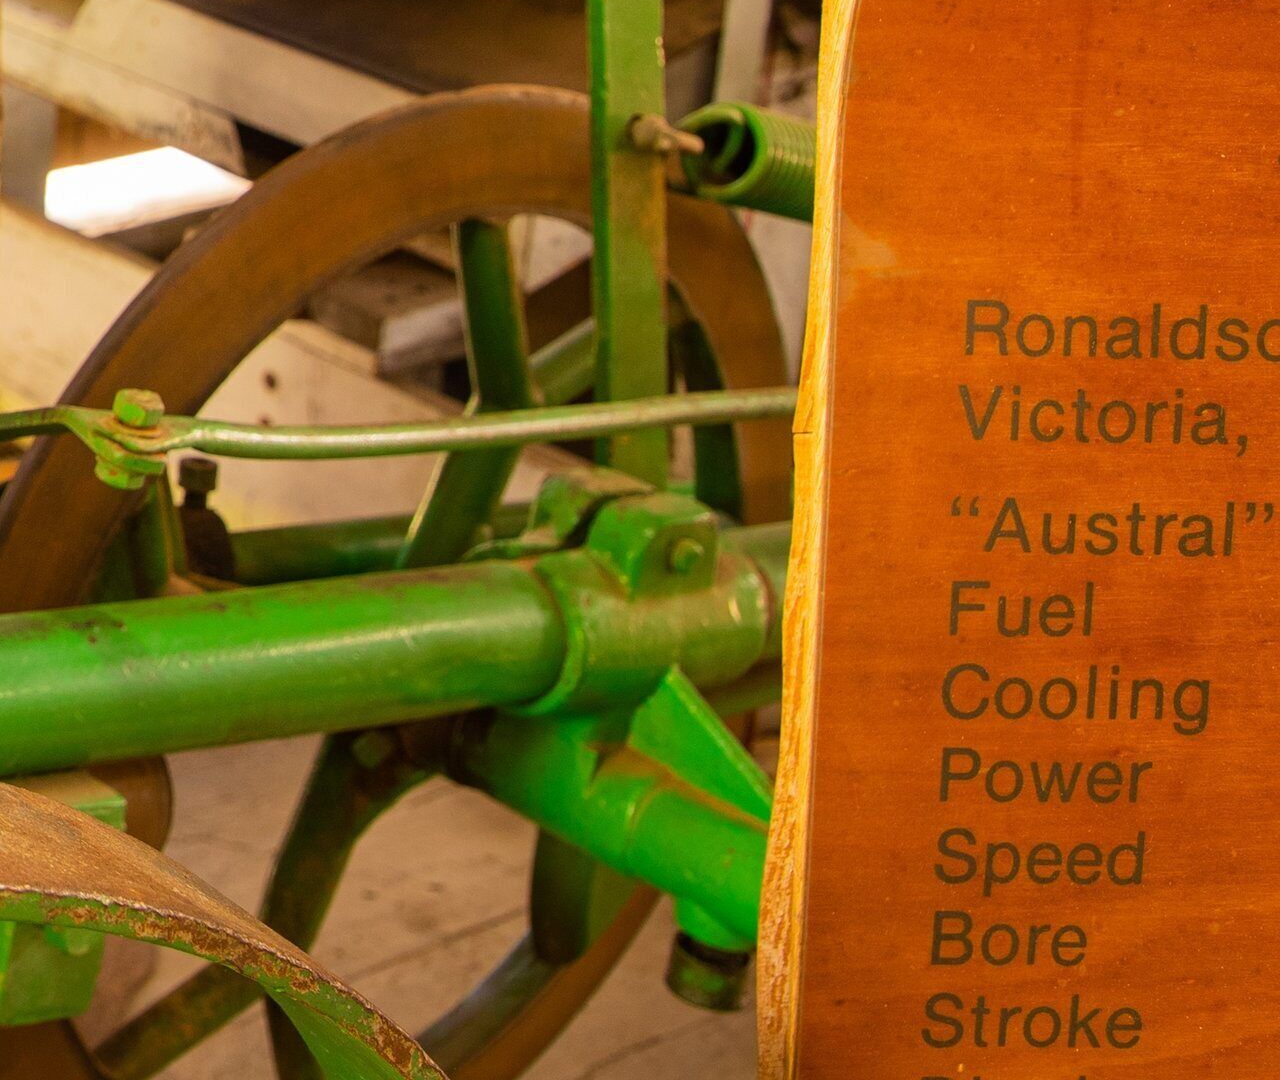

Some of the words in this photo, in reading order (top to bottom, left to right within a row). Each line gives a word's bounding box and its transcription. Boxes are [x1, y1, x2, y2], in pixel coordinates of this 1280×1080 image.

[958, 384, 1248, 457] Victoria,
[948, 580, 1094, 637] Fuel
[942, 663, 1210, 735] Cooling
[939, 747, 1153, 804] Power
[933, 827, 1146, 897] Speed
[930, 910, 1088, 967] Bore
[921, 991, 1143, 1049] Stroke
